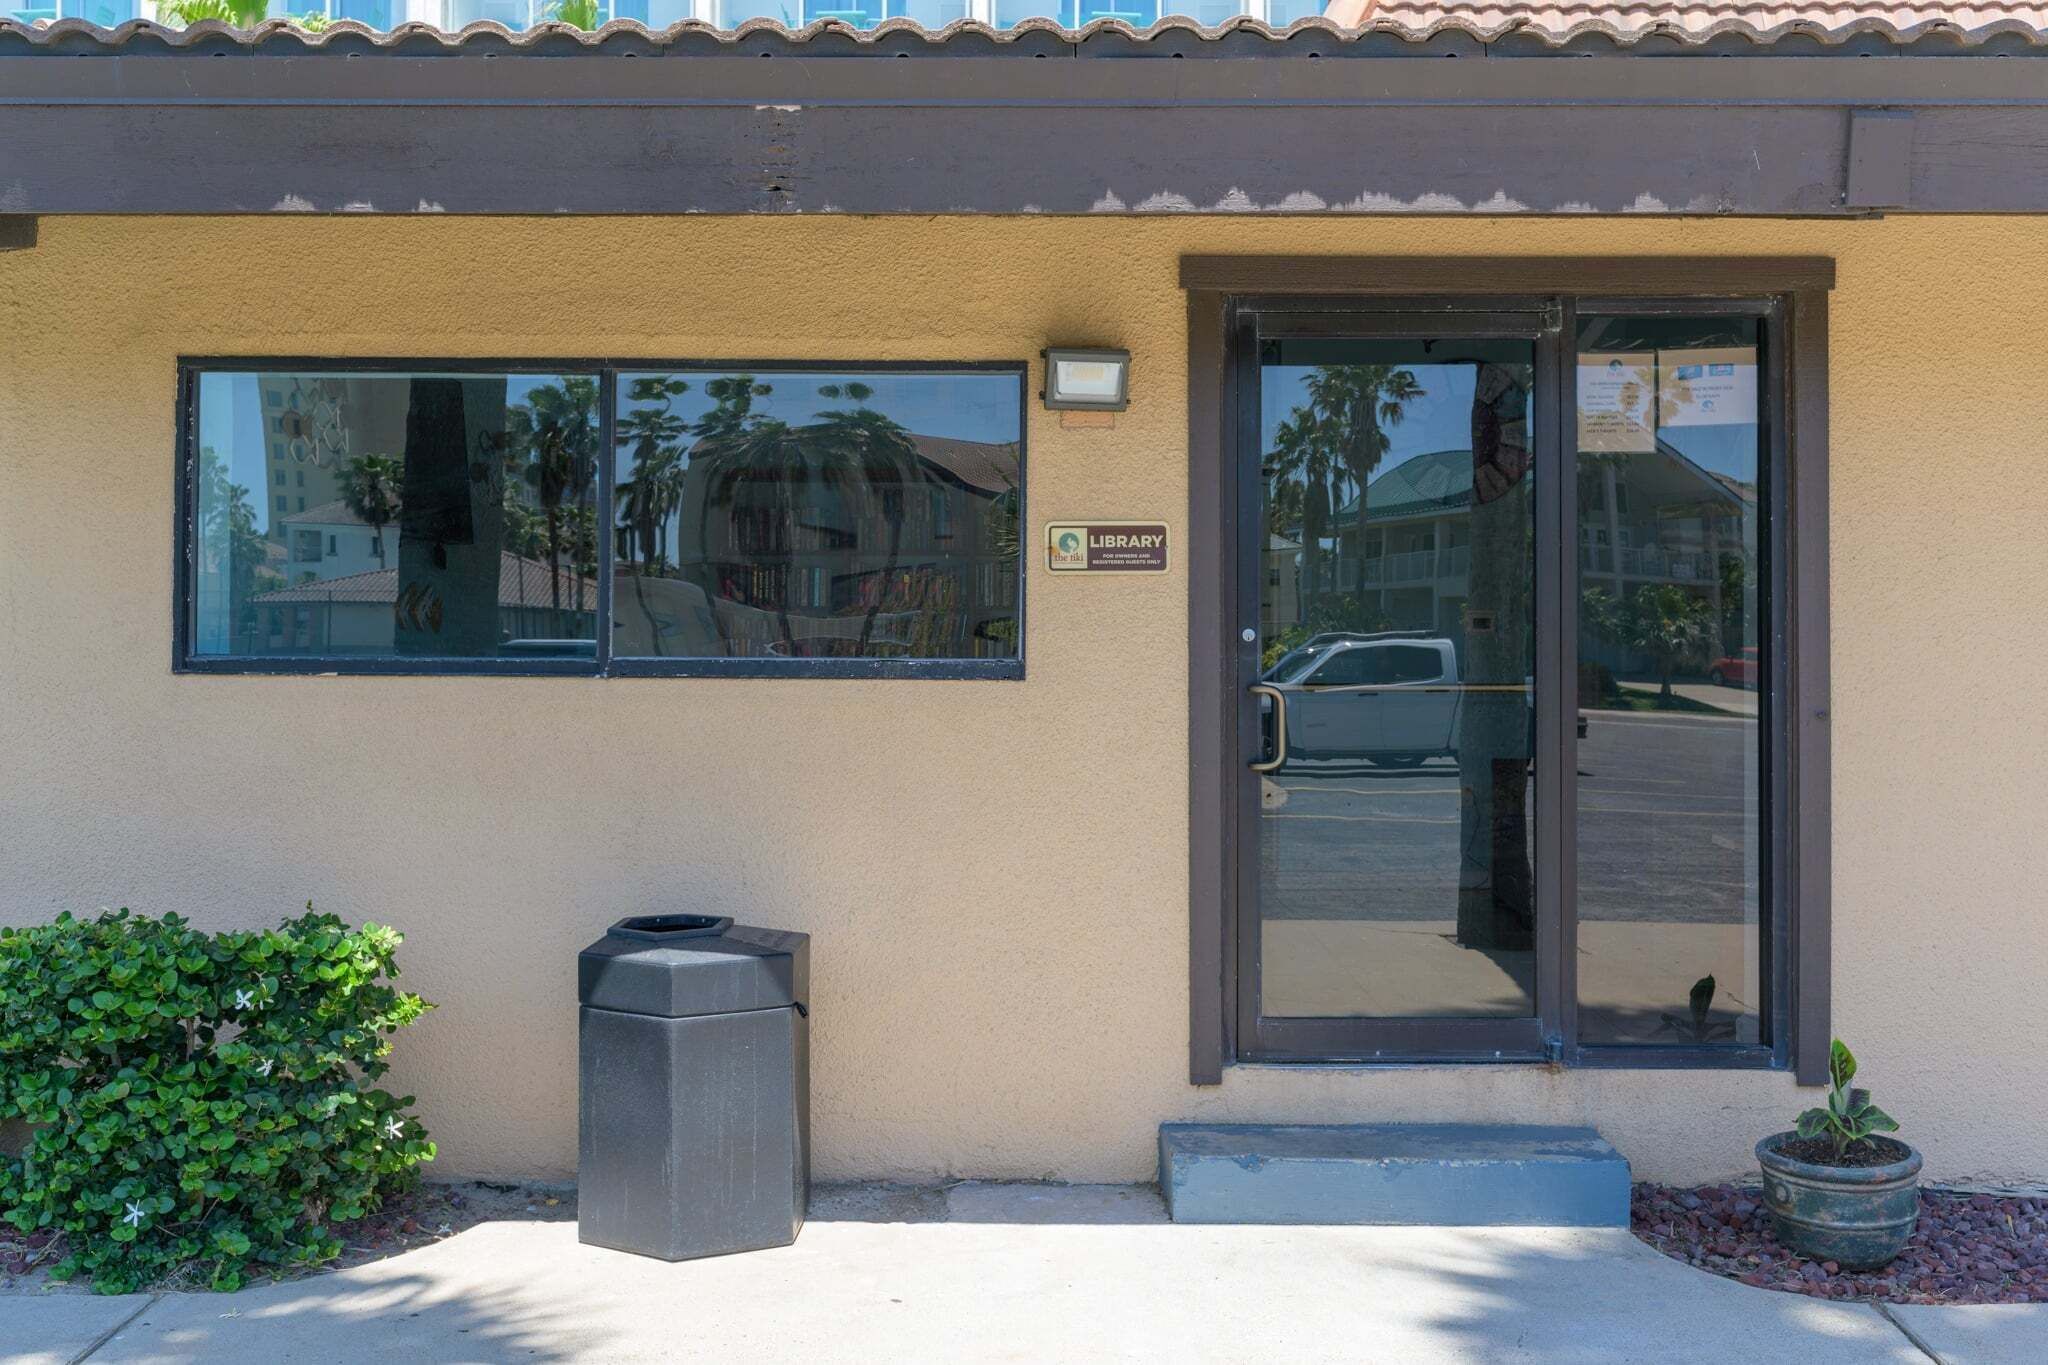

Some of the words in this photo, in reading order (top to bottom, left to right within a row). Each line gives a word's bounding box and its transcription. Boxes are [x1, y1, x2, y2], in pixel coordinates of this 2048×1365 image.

[1090, 535, 1163, 548] LIBRARY
[1055, 552, 1068, 562] the
[1070, 552, 1084, 562] tiki
